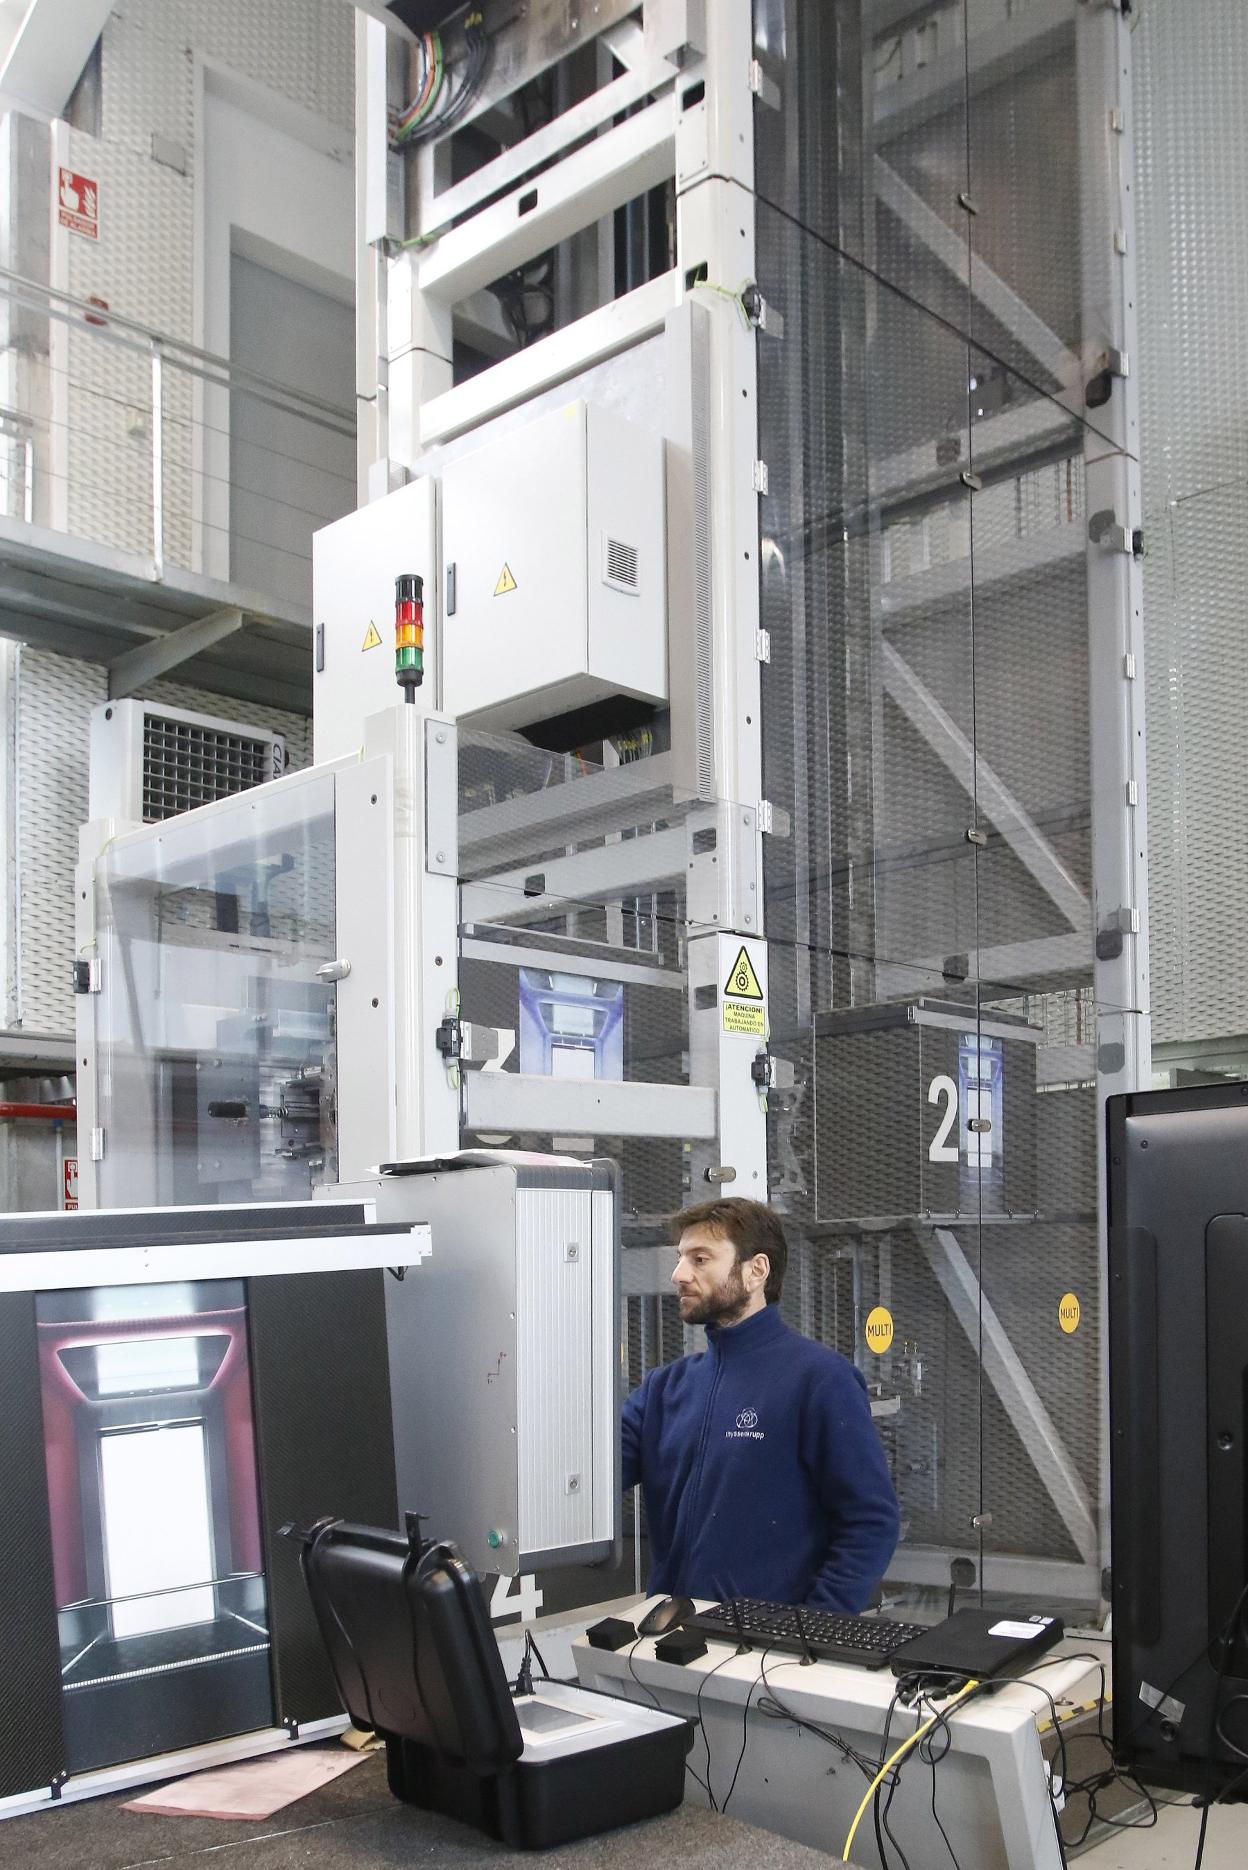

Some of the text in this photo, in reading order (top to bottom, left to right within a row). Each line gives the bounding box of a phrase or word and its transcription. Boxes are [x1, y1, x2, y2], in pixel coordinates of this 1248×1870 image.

[928, 1075, 958, 1161] 2
[1061, 1308, 1078, 1319] MULTI
[868, 1324, 891, 1337] MULTI
